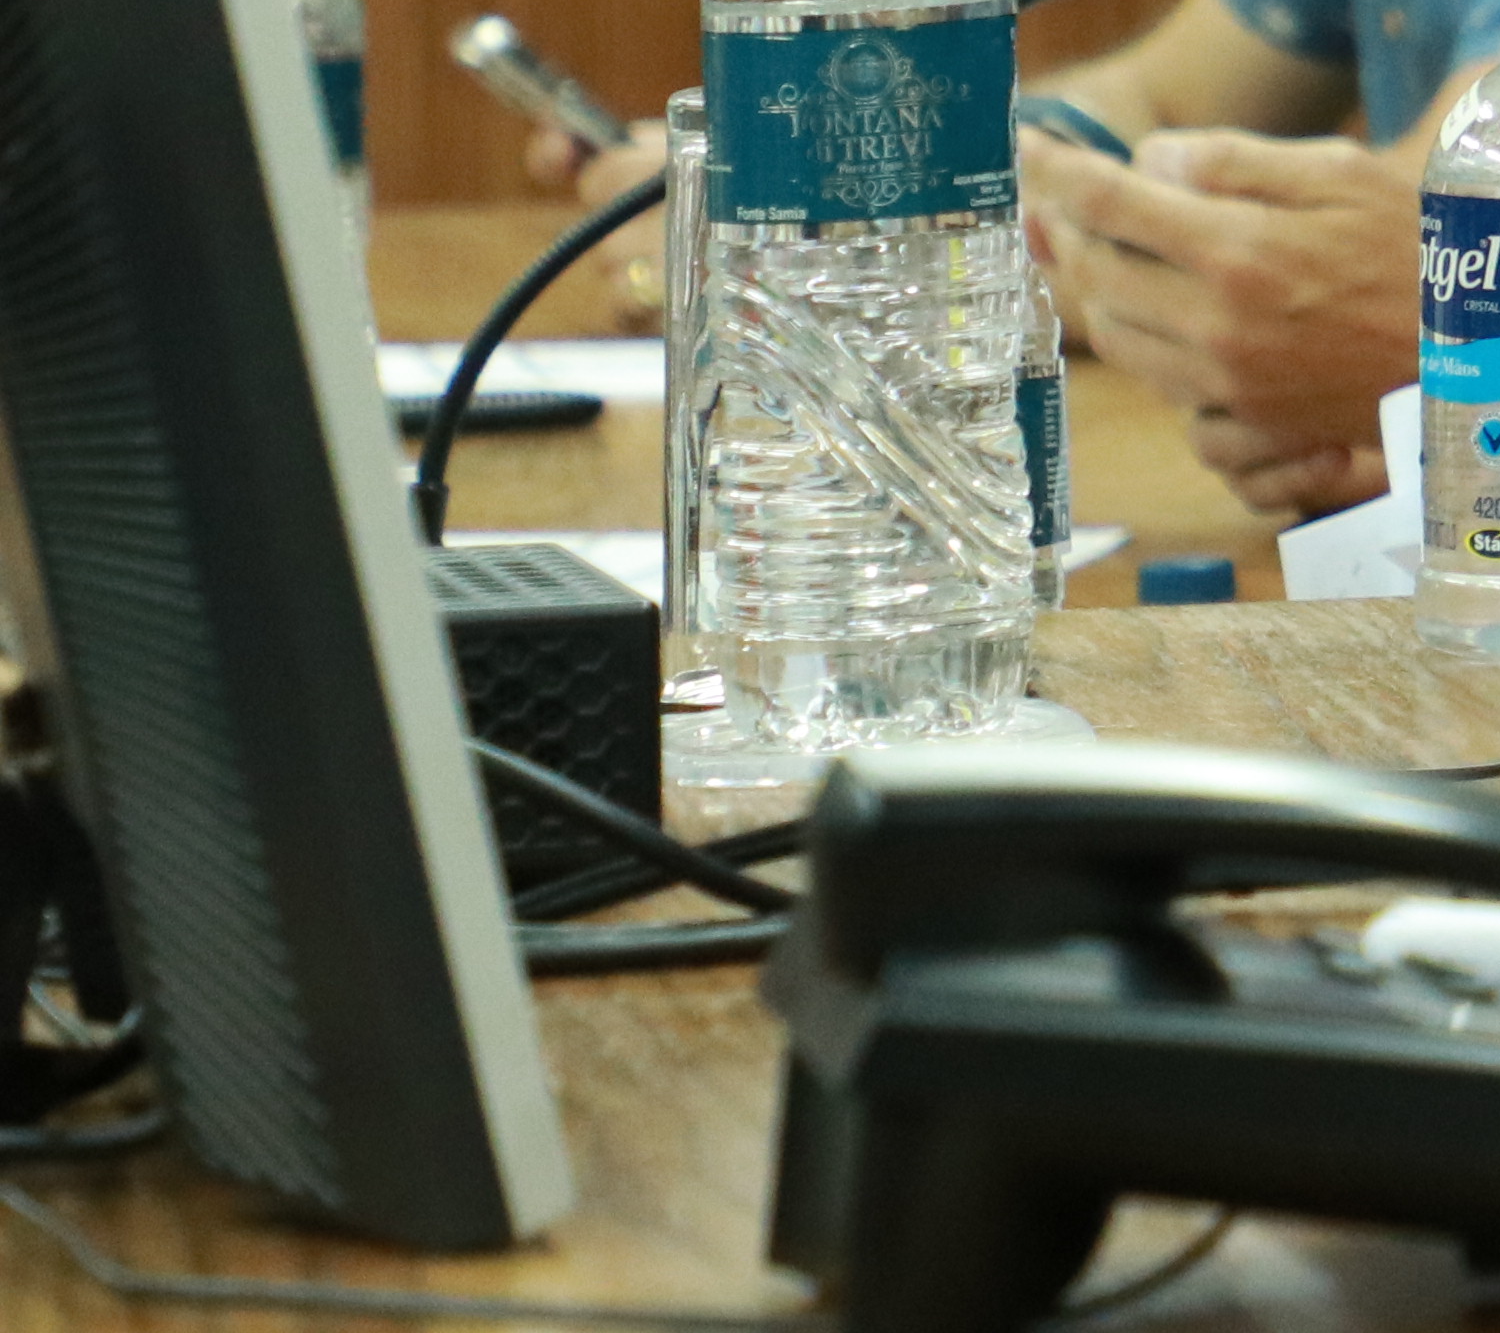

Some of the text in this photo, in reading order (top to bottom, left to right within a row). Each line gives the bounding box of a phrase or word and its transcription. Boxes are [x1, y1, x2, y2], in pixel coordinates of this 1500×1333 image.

[838, 131, 932, 162] TREVI
[736, 206, 766, 221] Fonte
[1464, 299, 1500, 313] CRISTAL
[1442, 356, 1481, 377] Mãos
